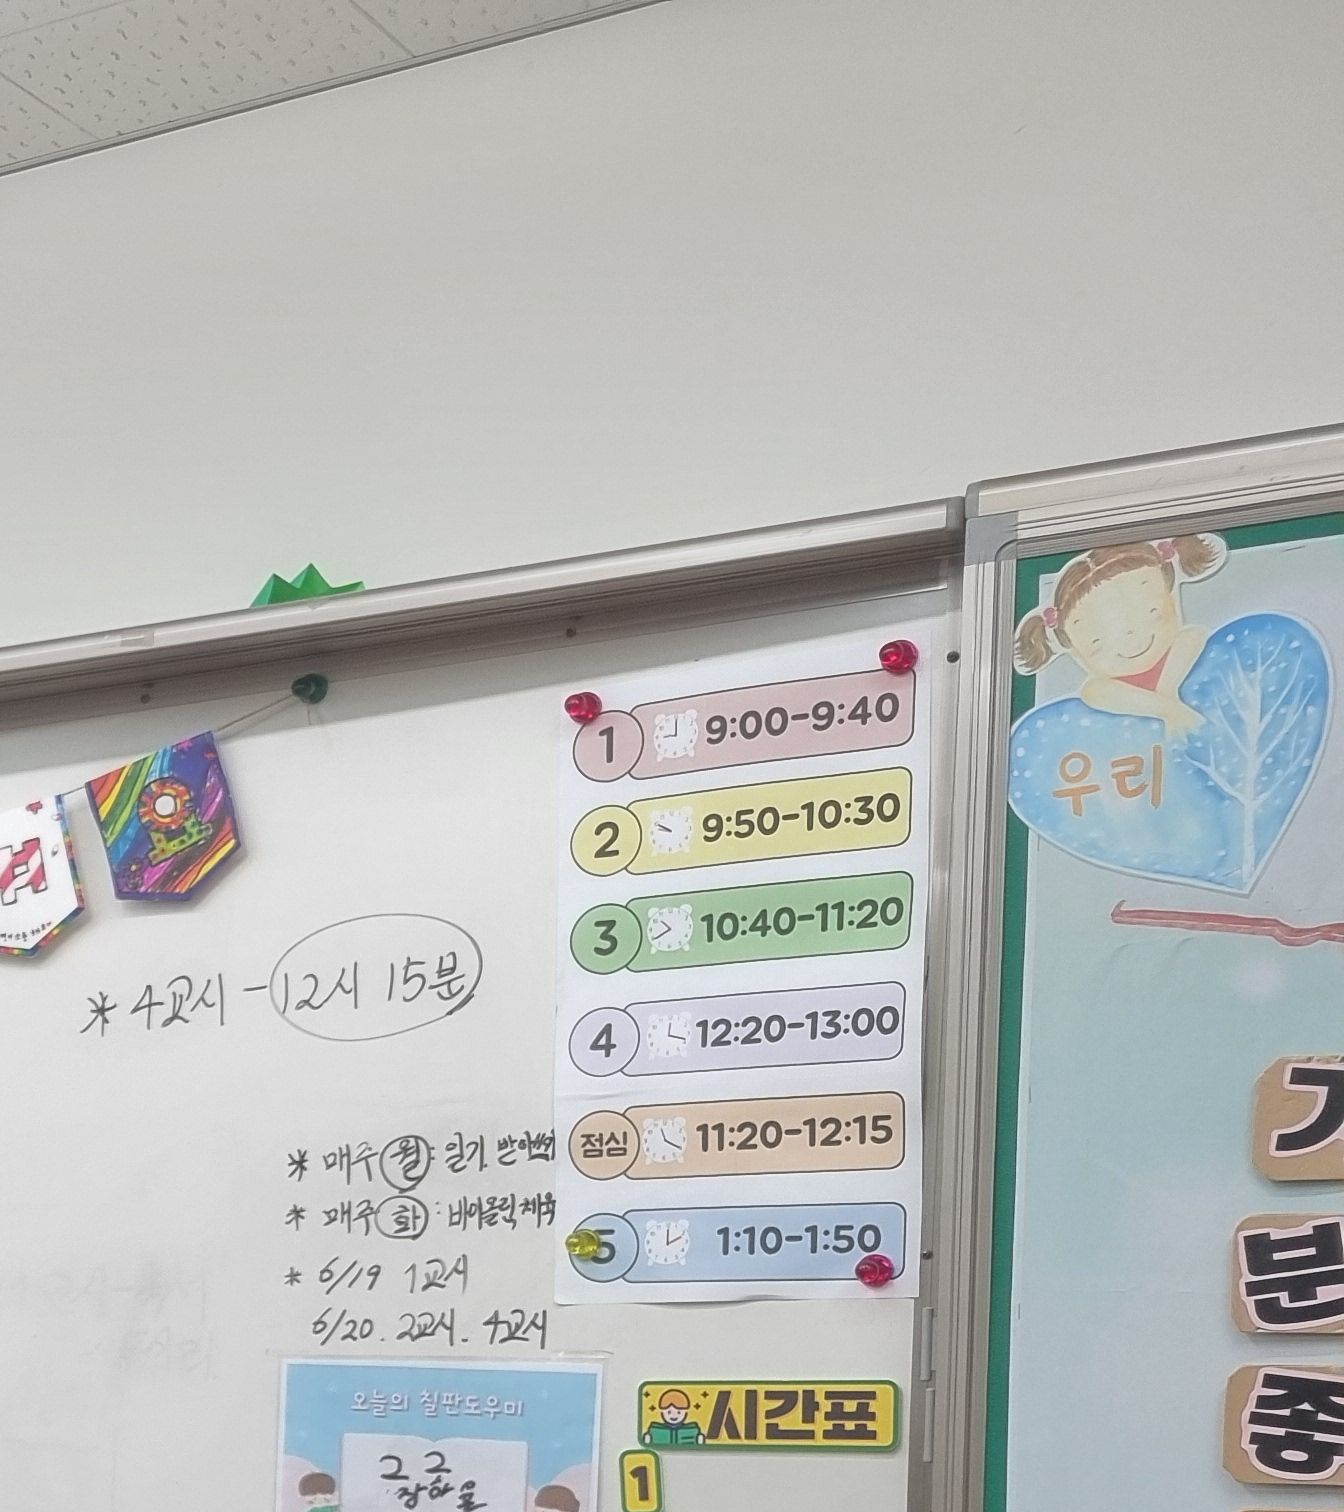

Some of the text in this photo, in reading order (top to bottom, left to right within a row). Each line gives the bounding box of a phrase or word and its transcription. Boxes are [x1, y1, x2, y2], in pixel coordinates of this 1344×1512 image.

[598, 693, 900, 763] 1 9:00-9:40
[1052, 745, 1163, 817] 우리
[594, 792, 901, 858] 2 9:50-10:30
[594, 896, 904, 956] 3 10:40-11:20
[589, 1005, 900, 1058] 4 12:20-13:00
[580, 1114, 894, 1158] 점심 11:20-12:15
[716, 1224, 882, 1256] 1:10-1:50
[350, 1390, 409, 1417] 오늘의
[705, 1389, 878, 1441] 시간표
[629, 1465, 651, 1501] 1
